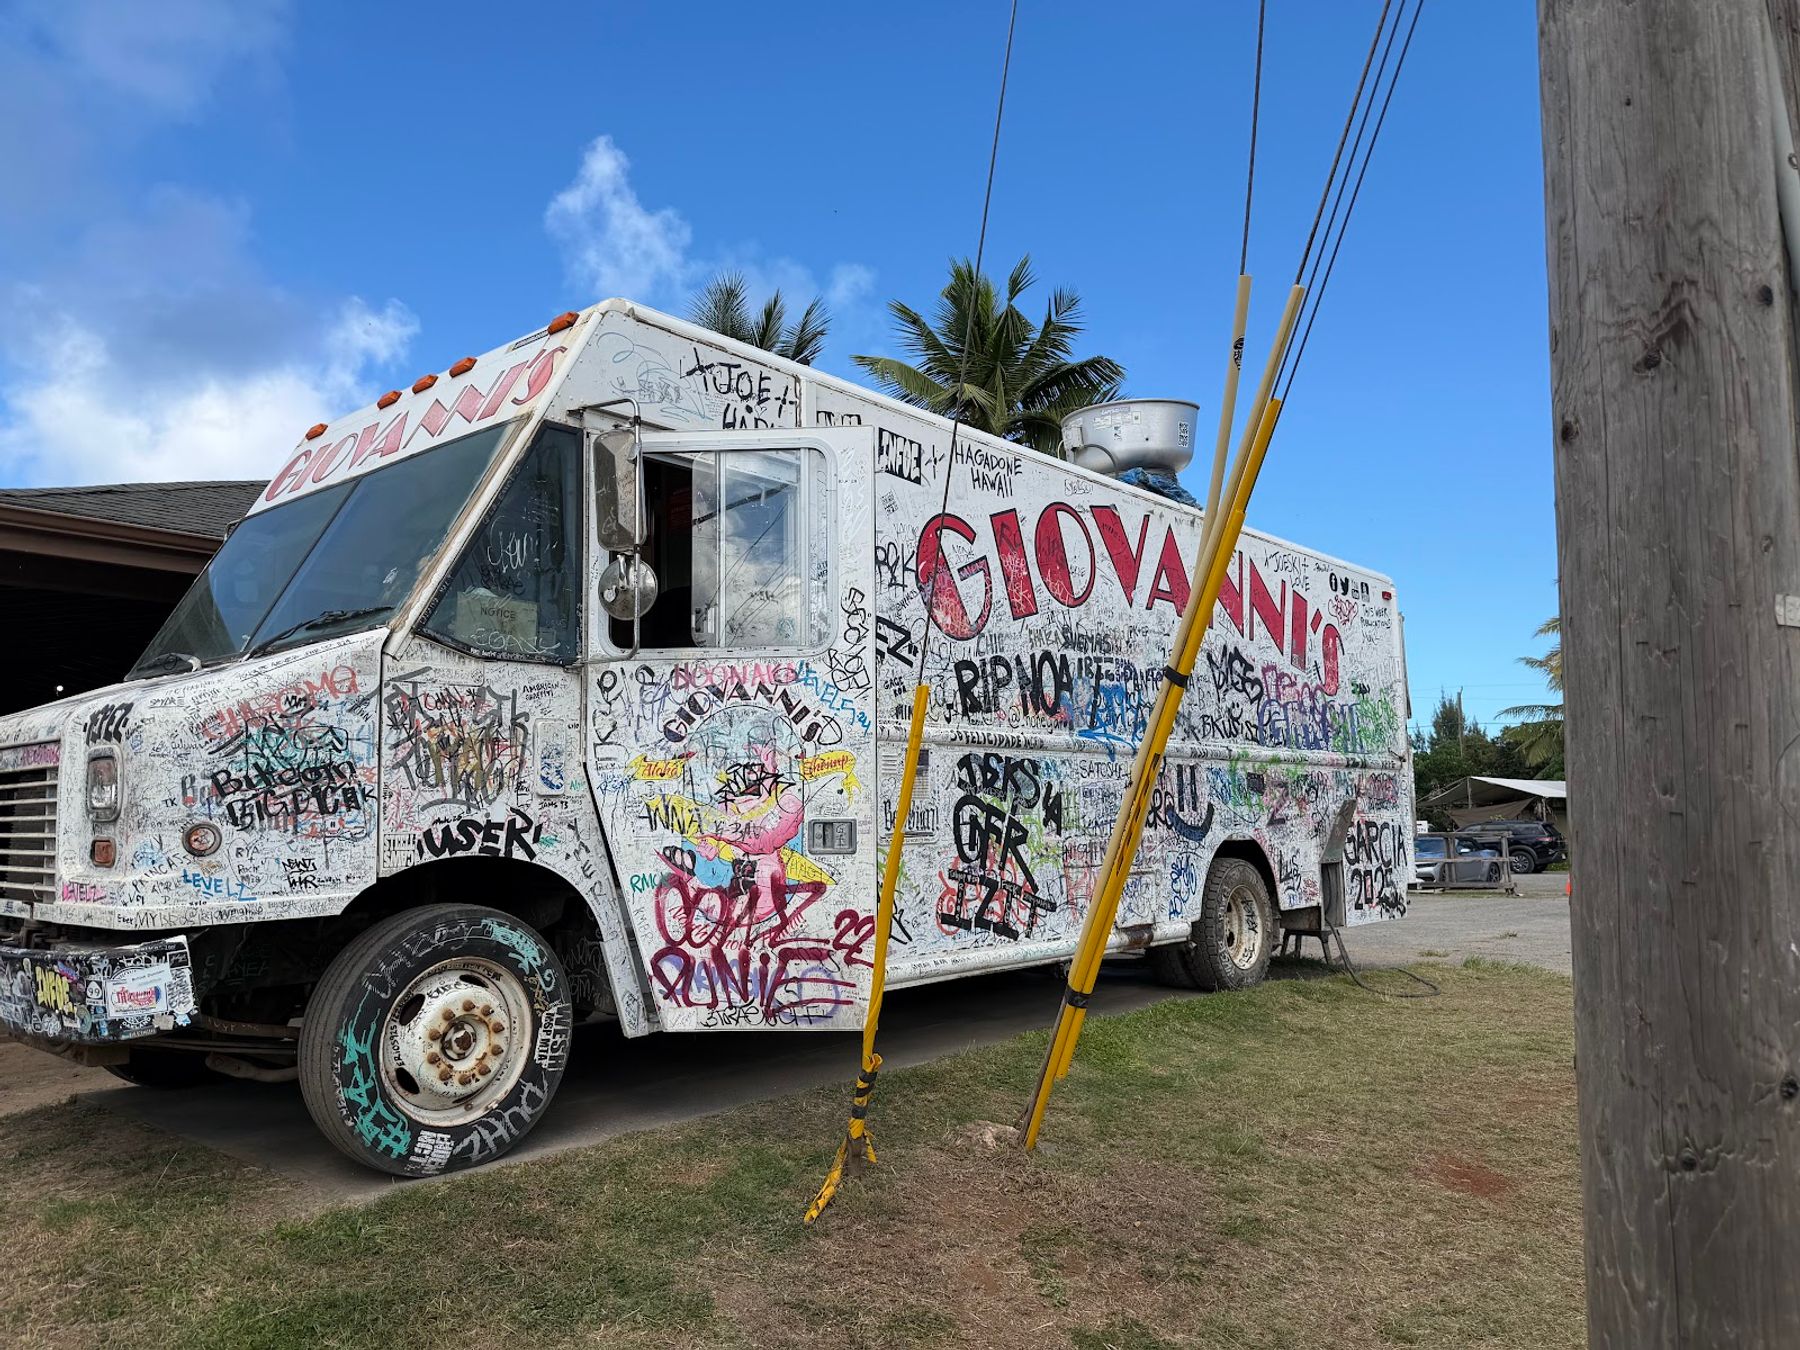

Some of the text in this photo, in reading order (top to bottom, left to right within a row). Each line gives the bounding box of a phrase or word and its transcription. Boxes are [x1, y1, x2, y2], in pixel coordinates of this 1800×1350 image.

[955, 440, 1023, 476] HAGADONE
[971, 467, 1014, 499] HAWAII
[954, 654, 1013, 718] RIP
[1344, 818, 1408, 869] GARCIA
